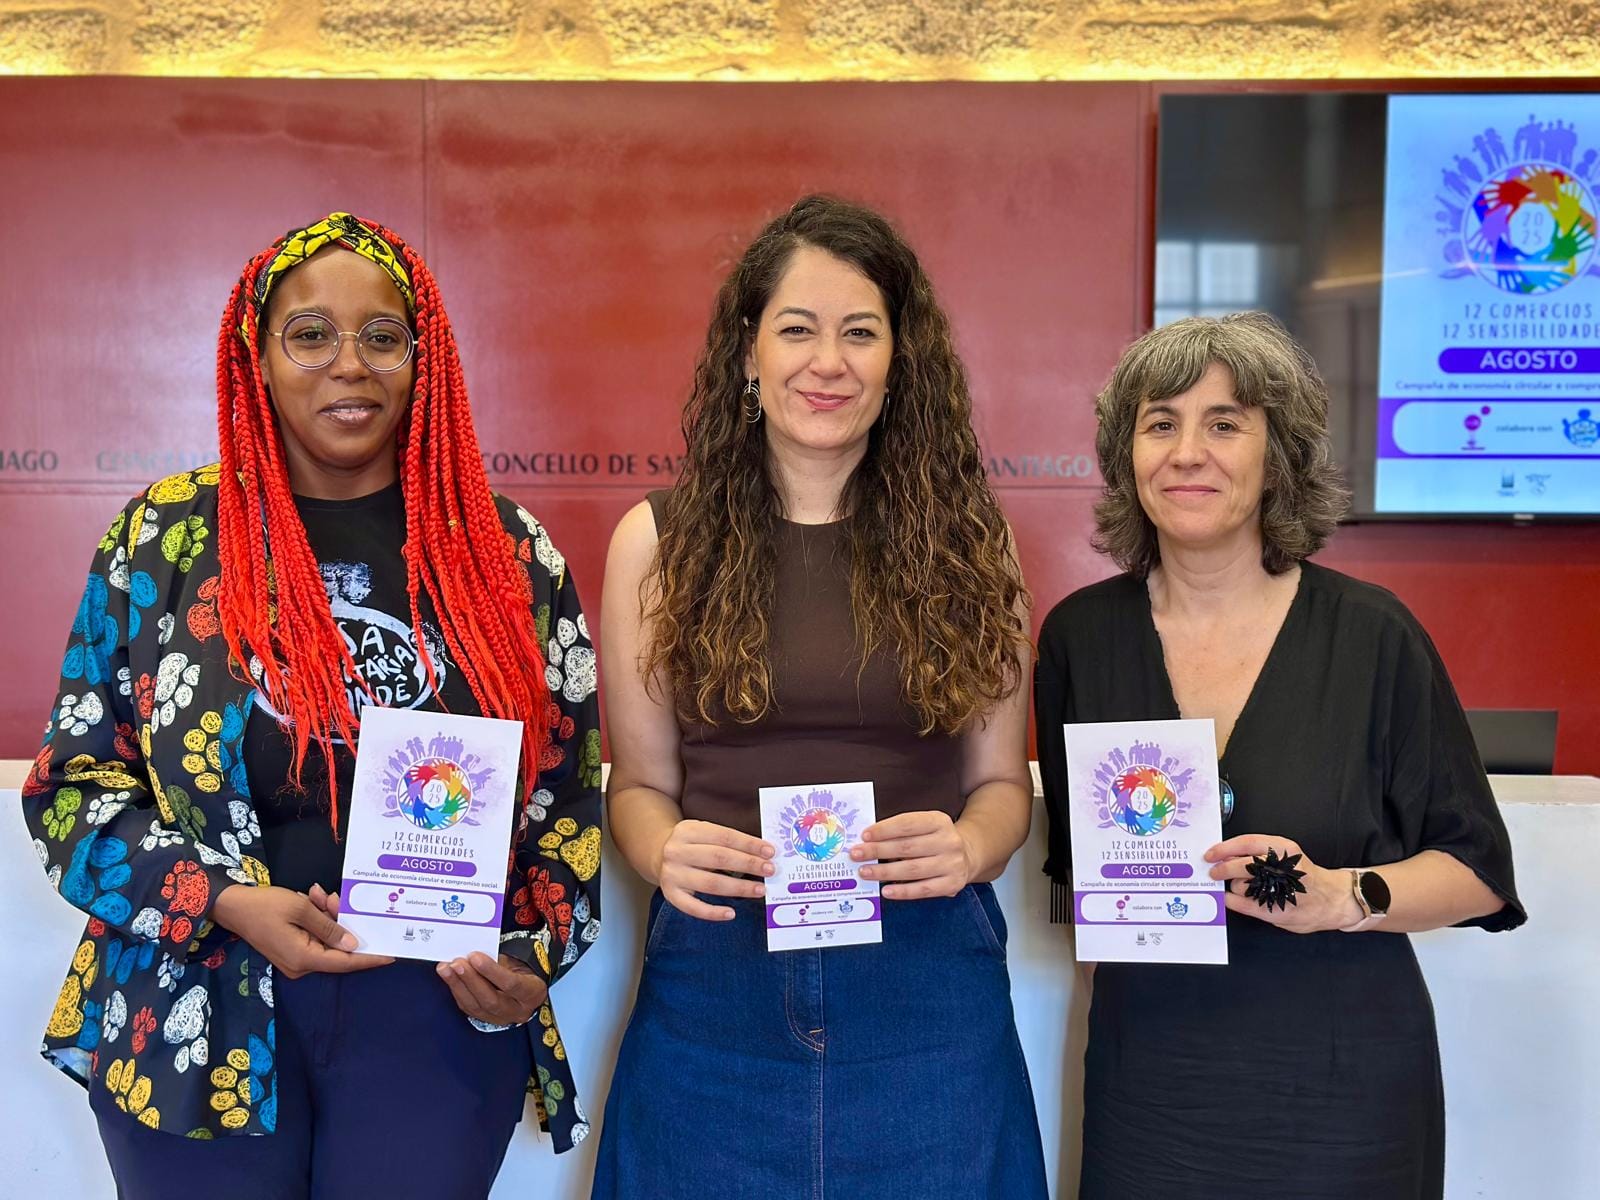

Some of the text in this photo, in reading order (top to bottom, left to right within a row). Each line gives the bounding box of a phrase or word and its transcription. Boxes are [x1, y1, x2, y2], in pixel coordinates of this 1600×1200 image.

[1464, 302, 1593, 319] 12 COMERCIOS
[1443, 322, 1461, 339] 12
[1480, 350, 1578, 370] AGOSTO
[609, 453, 638, 475] DE
[394, 831, 465, 847] 12 COMERCIOS
[1111, 840, 1177, 849] 12 COMERCIOS
[381, 841, 475, 859] 12 SENSIBILIDADES
[1102, 850, 1189, 860] 12 SENSIBILIDADES
[400, 858, 454, 872] AGOSTO
[805, 863, 846, 872] COMERCIOS
[1122, 865, 1171, 875] AGOSTO
[352, 869, 380, 878] Campaña
[797, 869, 854, 880] SENSIBILIDADES
[803, 880, 841, 890] AGOSTO
